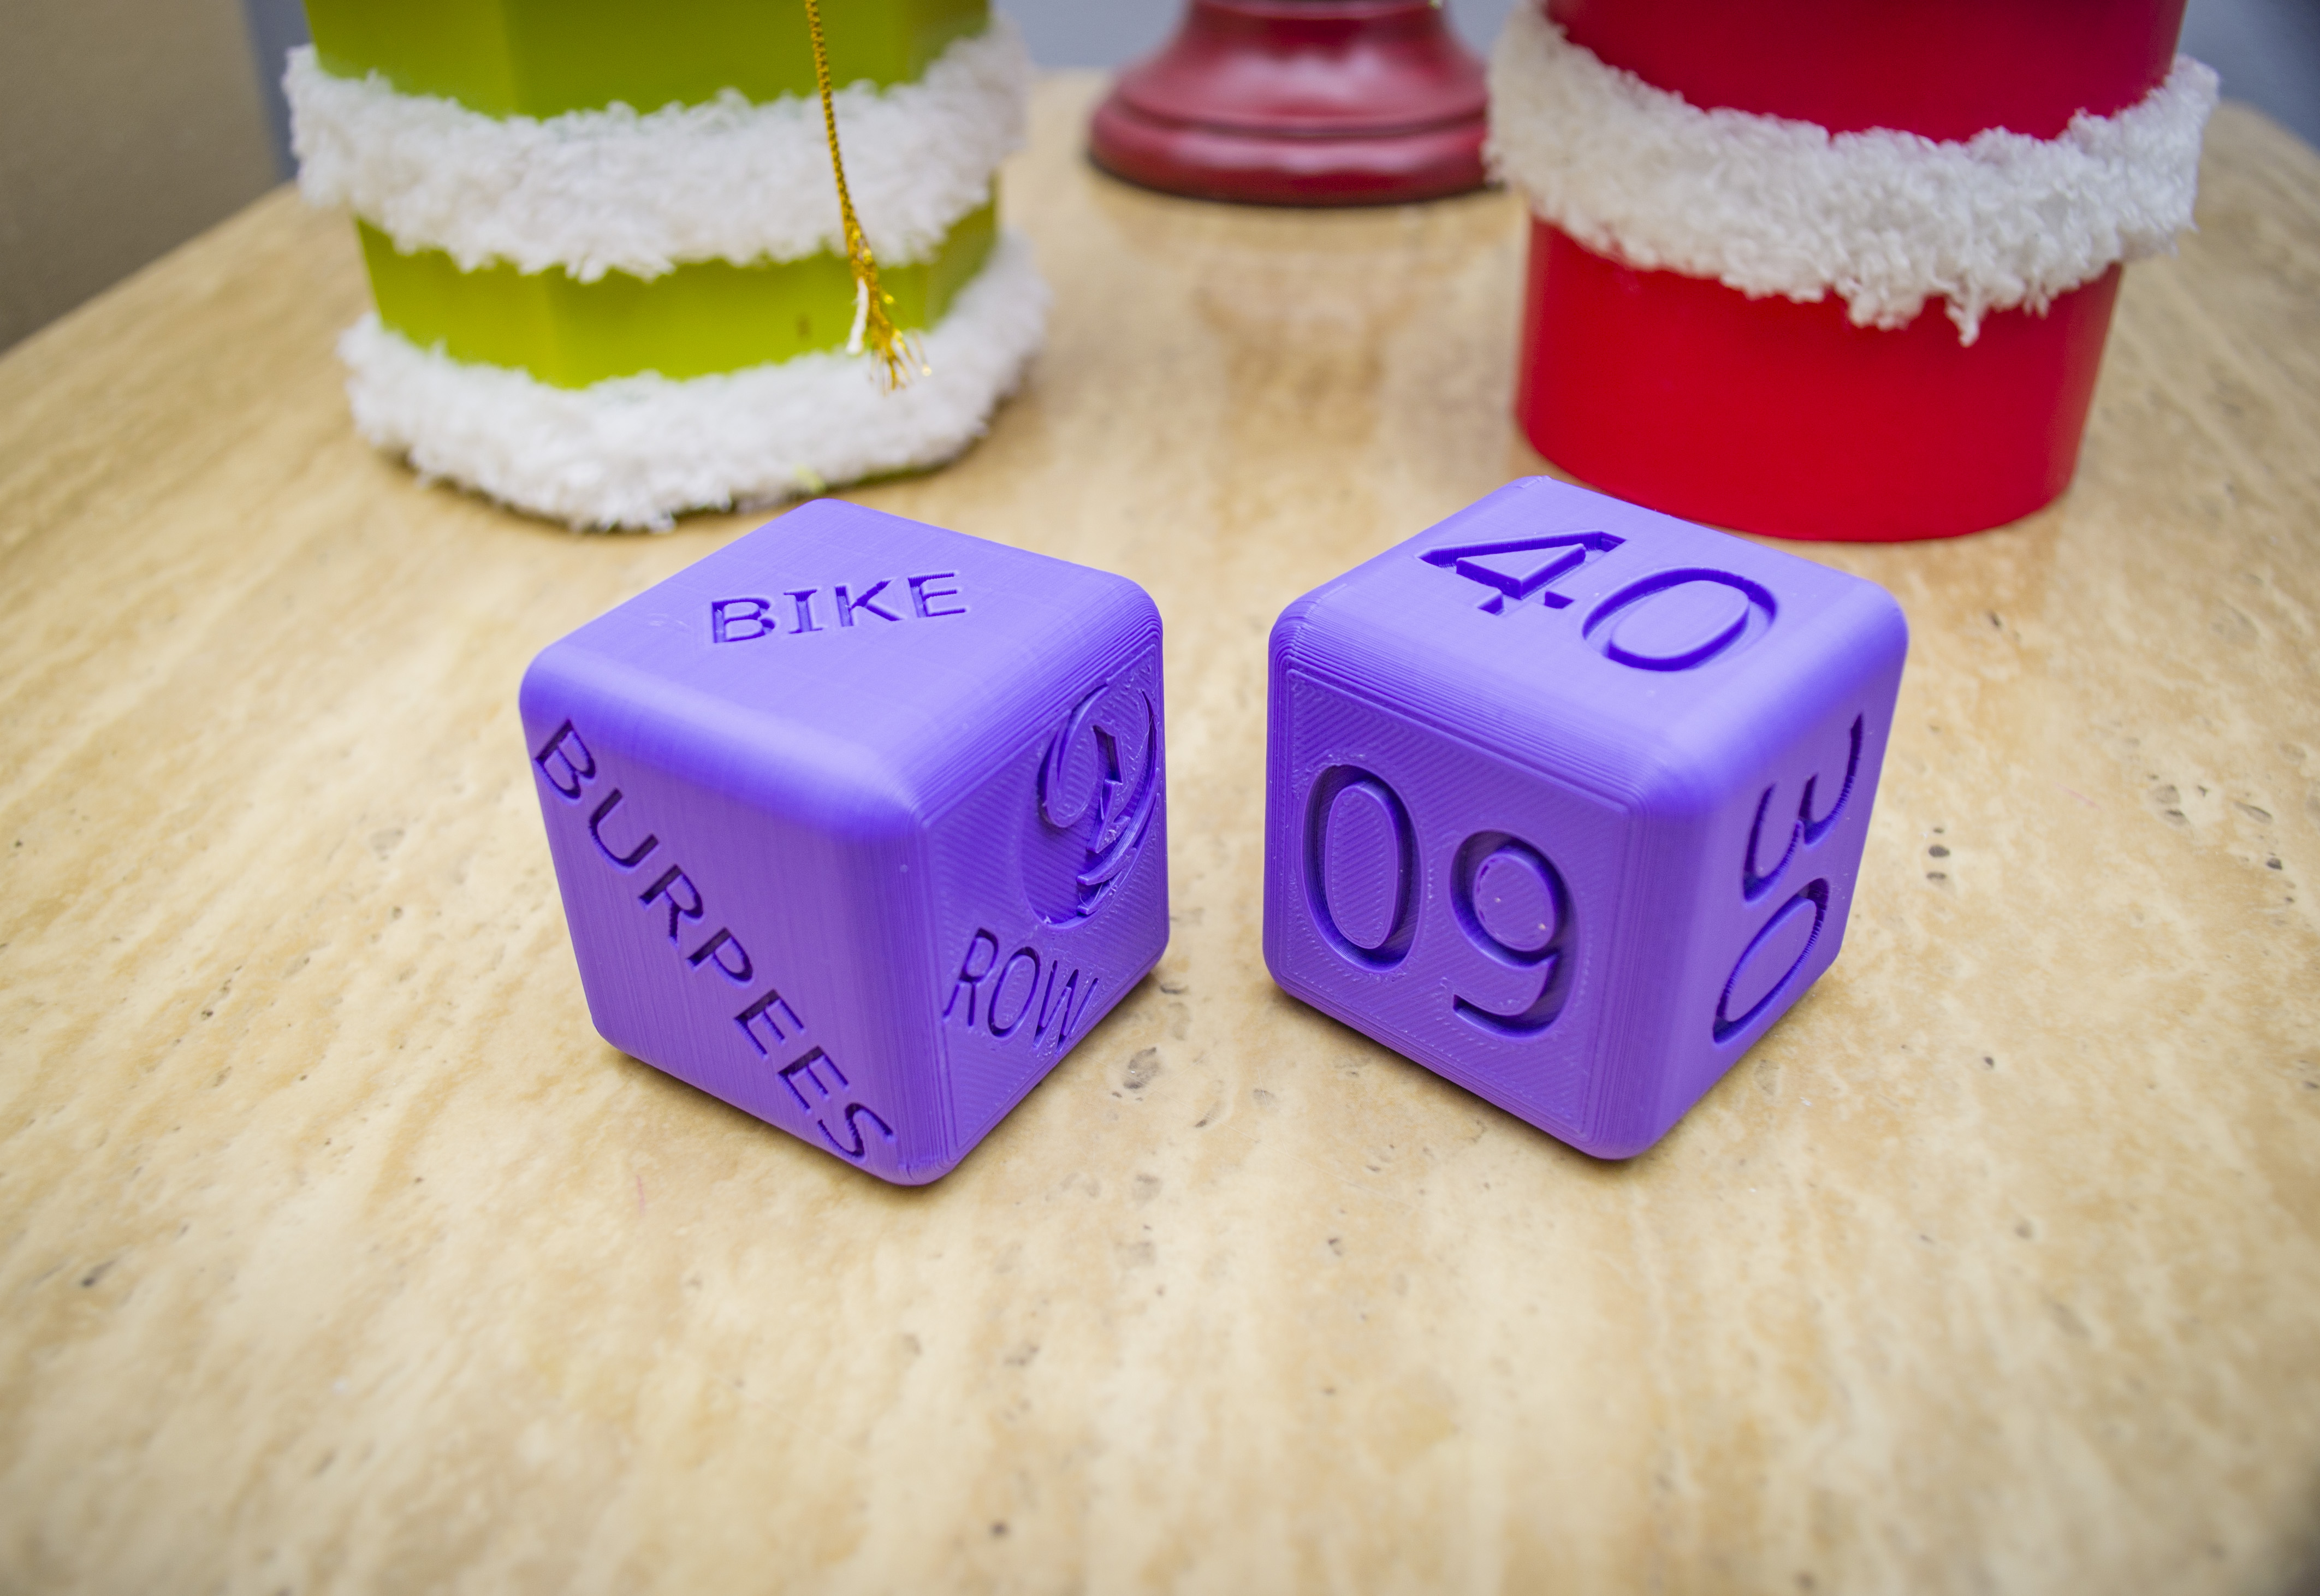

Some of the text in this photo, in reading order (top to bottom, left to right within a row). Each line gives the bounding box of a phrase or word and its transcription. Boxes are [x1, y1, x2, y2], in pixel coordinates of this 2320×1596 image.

[711, 571, 969, 644] BIKE
[1419, 531, 1778, 672] 40
[535, 719, 897, 1160] BURPEES
[1712, 714, 1864, 1044] 30
[943, 927, 1100, 1058] ROW
